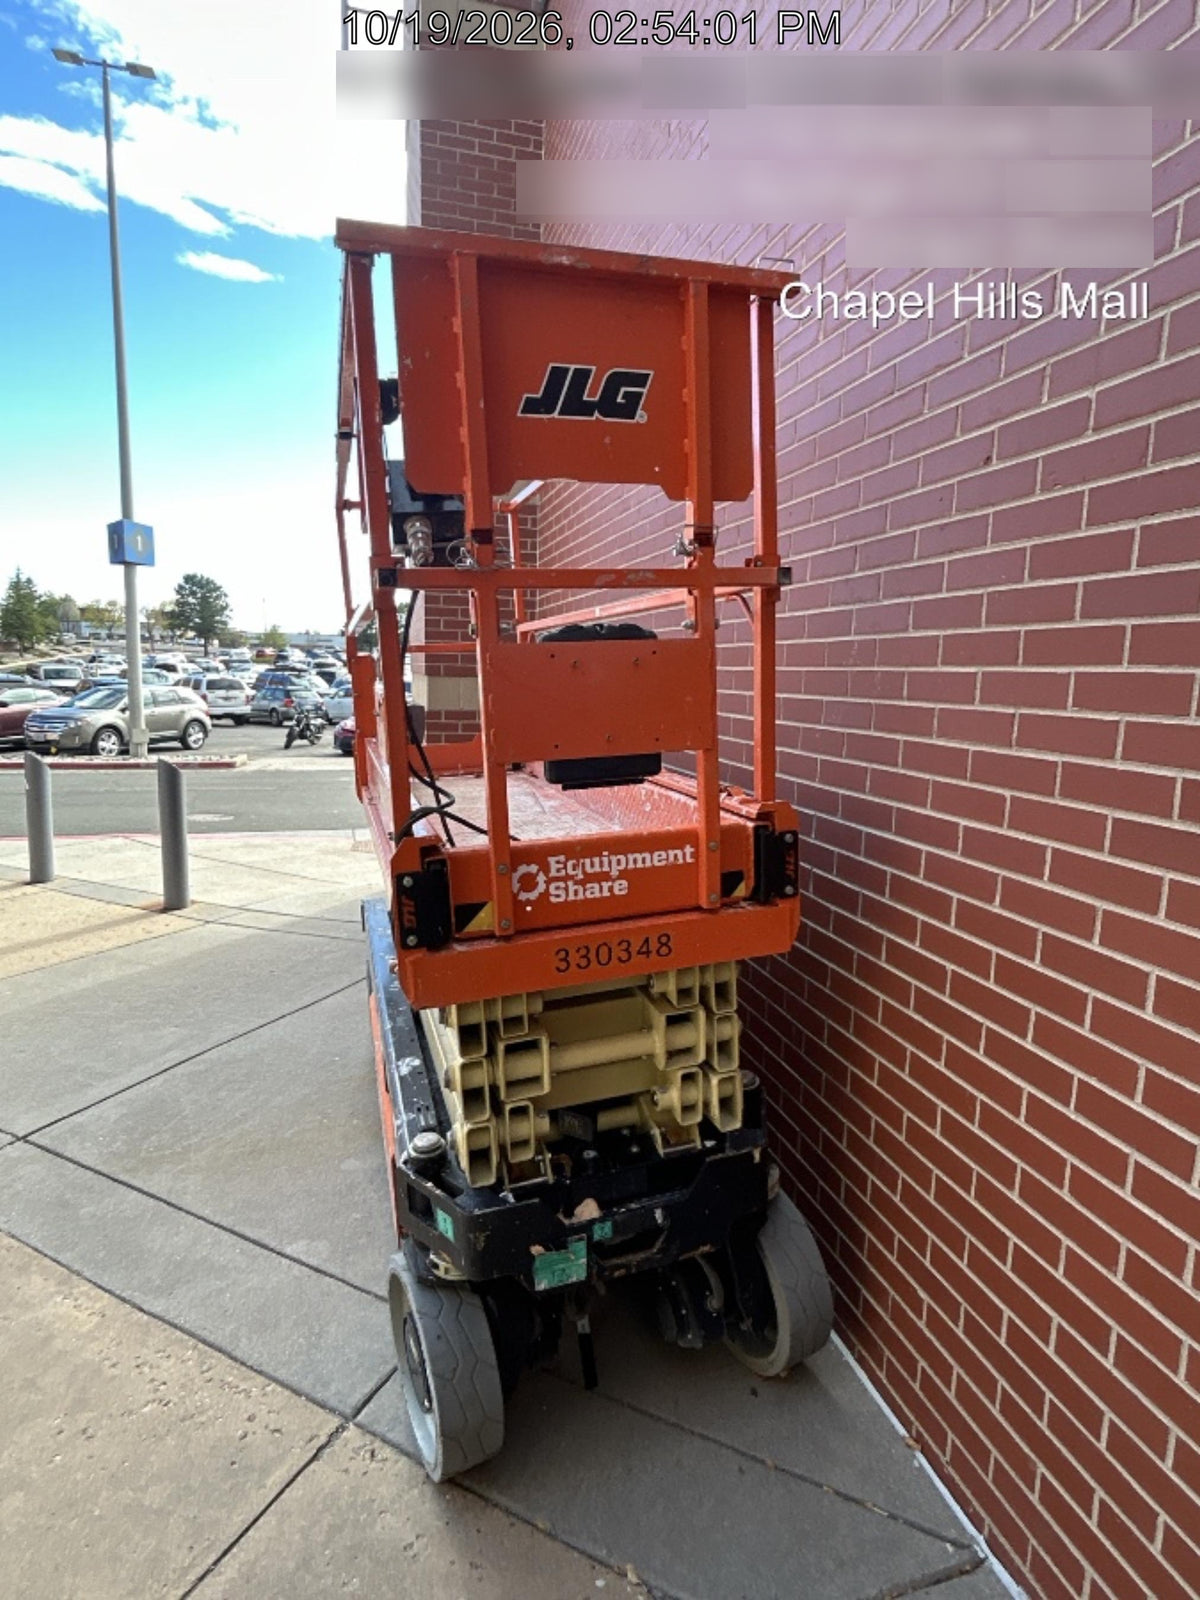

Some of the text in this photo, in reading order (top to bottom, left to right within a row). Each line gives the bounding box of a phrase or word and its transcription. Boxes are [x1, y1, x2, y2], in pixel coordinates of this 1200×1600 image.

[517, 362, 655, 423] JLG
[135, 534, 143, 552] 1
[547, 844, 696, 881] Equipment
[549, 878, 629, 903] Share
[554, 932, 674, 974] 330348
